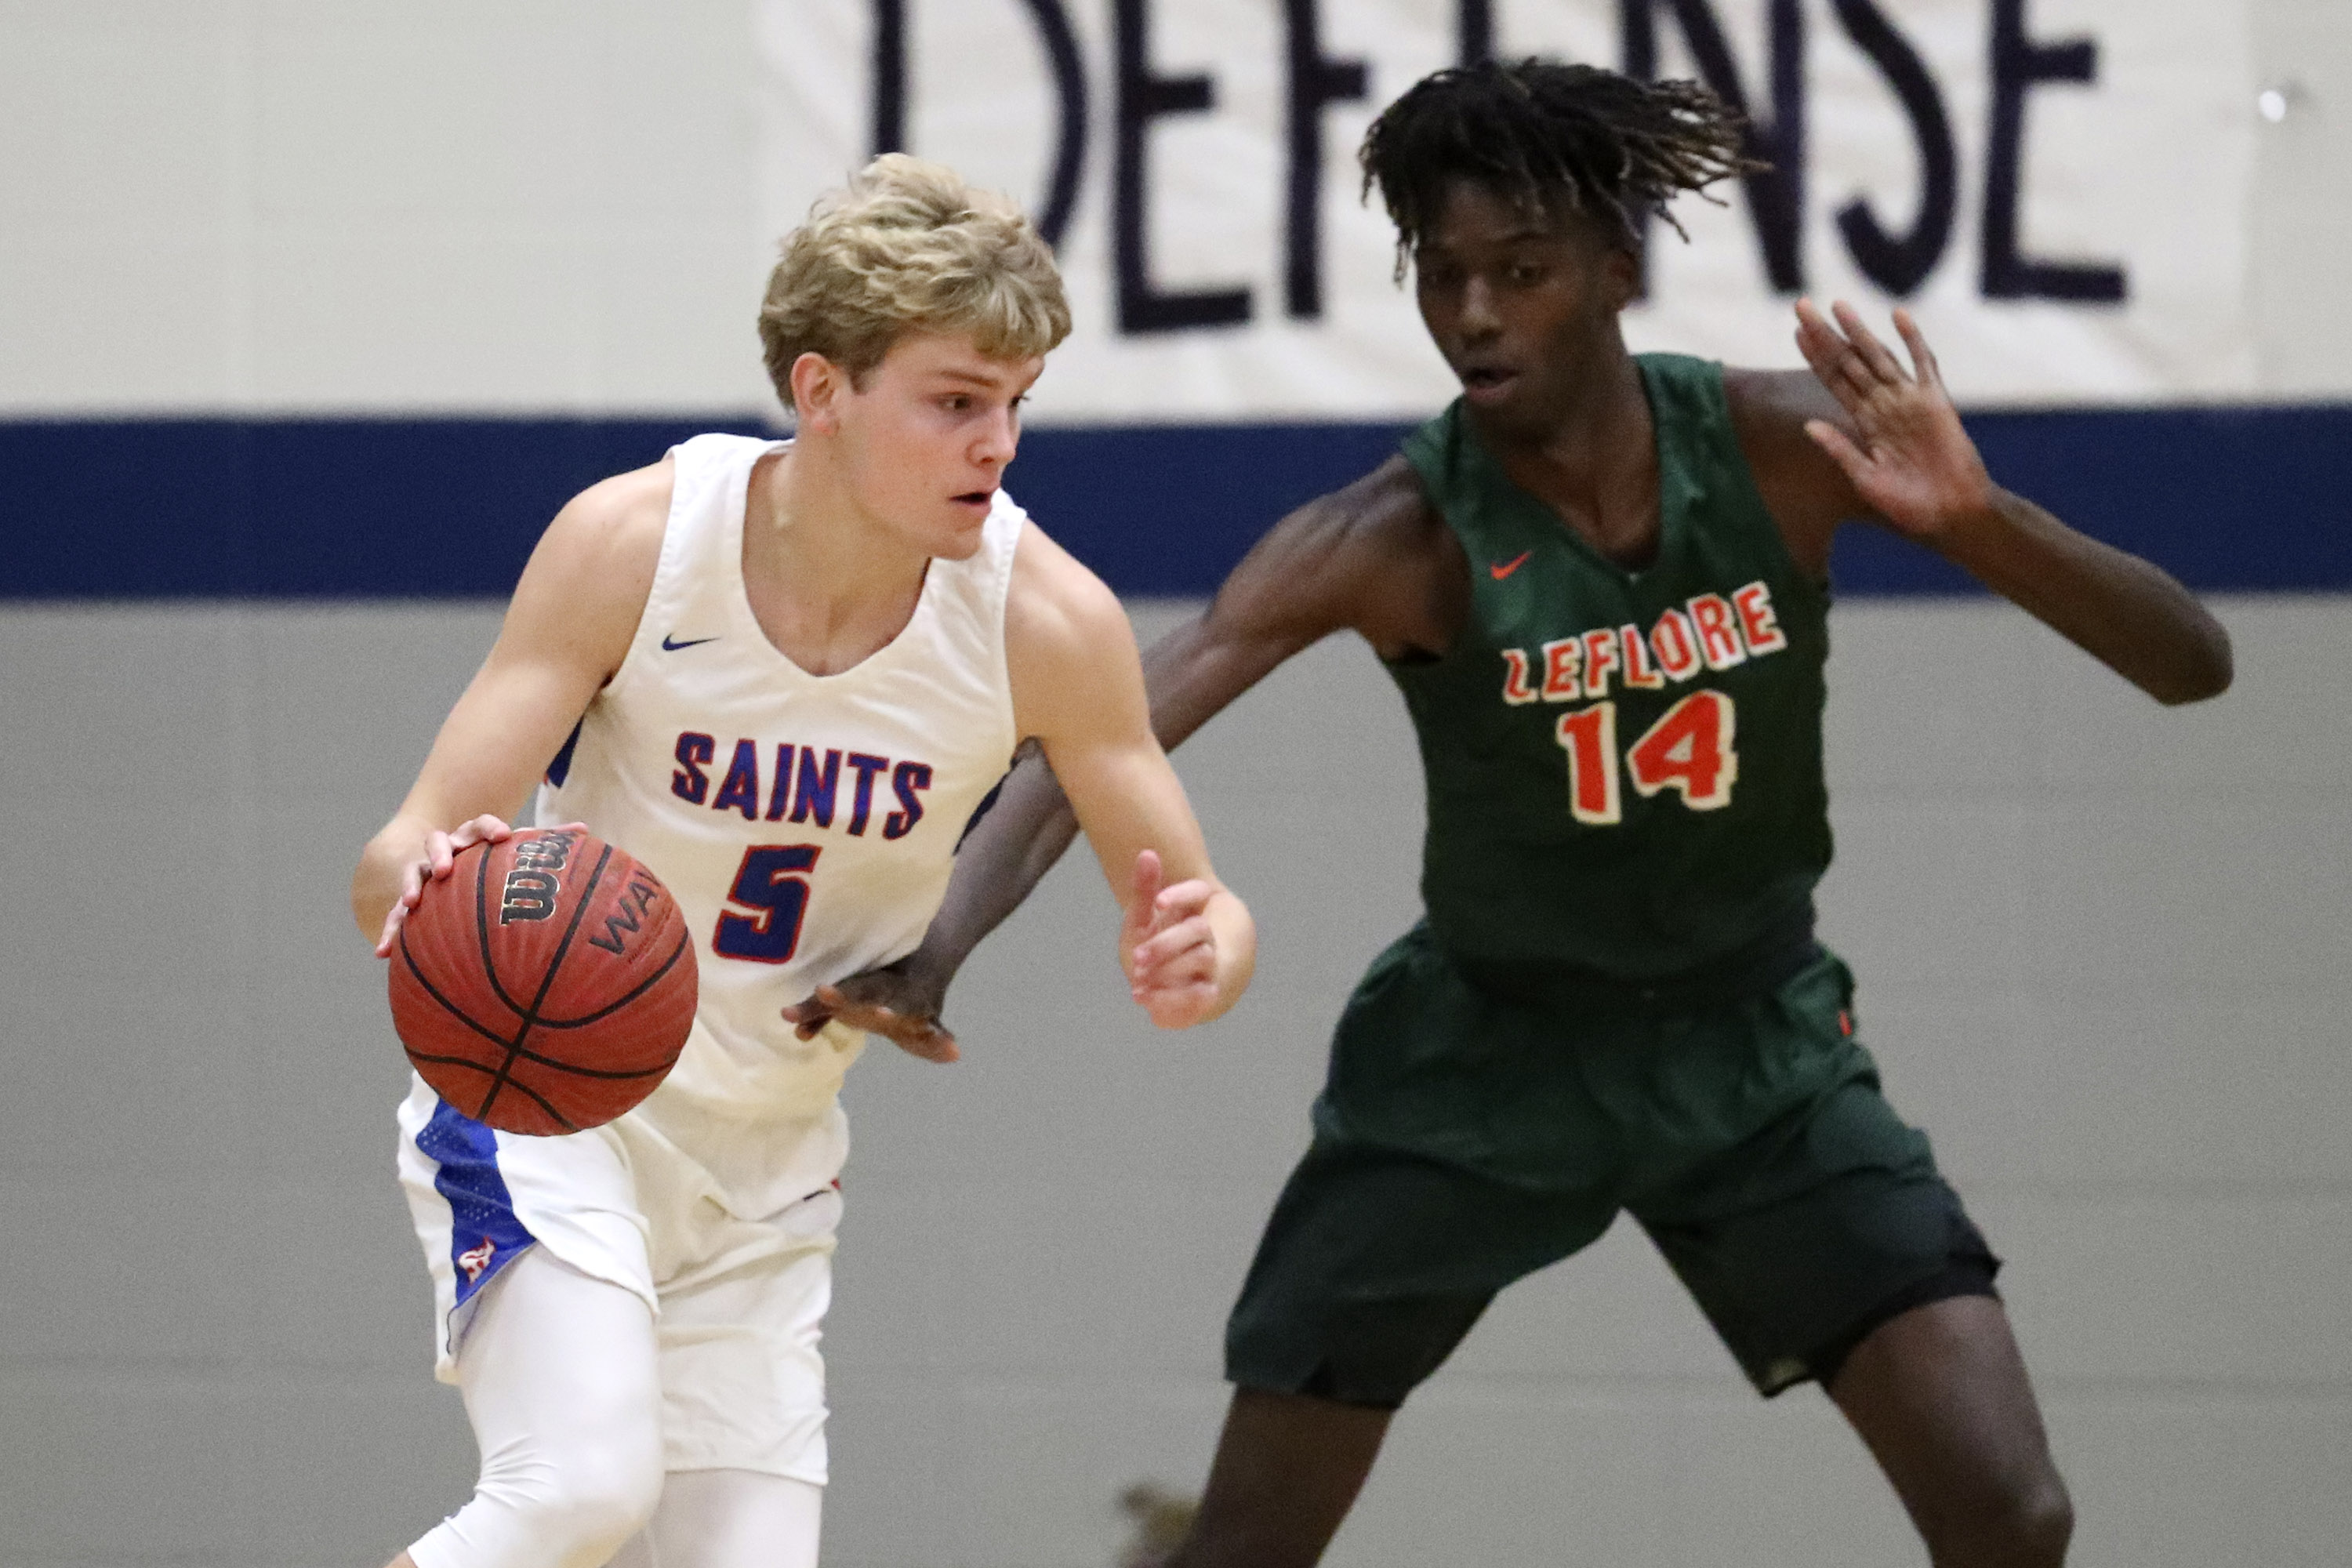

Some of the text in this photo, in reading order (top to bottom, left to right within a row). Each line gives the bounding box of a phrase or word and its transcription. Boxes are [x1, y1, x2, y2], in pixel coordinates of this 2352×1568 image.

[872, 0, 2131, 335] DEFNSE
[1501, 580, 1788, 704] LEFLORE
[671, 731, 933, 840] SAINTS
[1556, 689, 1738, 824] 14
[712, 843, 822, 964] 5
